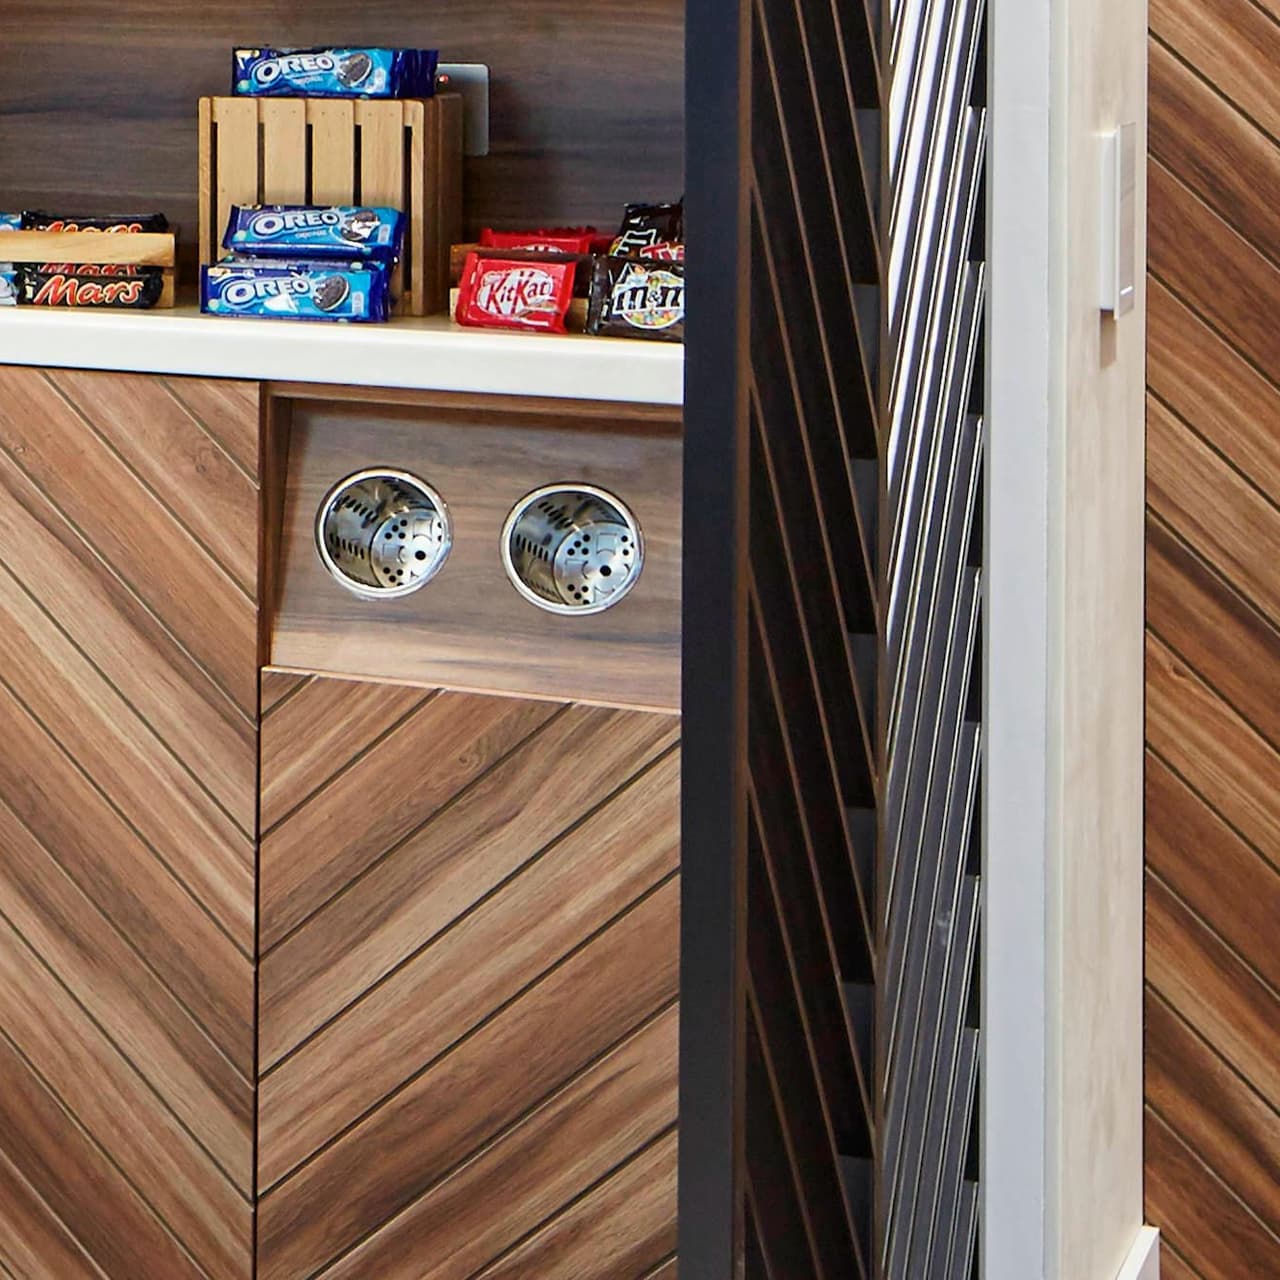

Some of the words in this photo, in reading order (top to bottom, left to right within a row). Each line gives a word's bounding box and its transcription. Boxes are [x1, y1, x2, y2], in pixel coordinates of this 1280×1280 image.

[256, 55, 335, 85] OREO
[253, 210, 339, 237] OREO
[33, 275, 144, 306] Mars
[223, 275, 311, 305] OREO
[486, 270, 548, 315] KitKat
